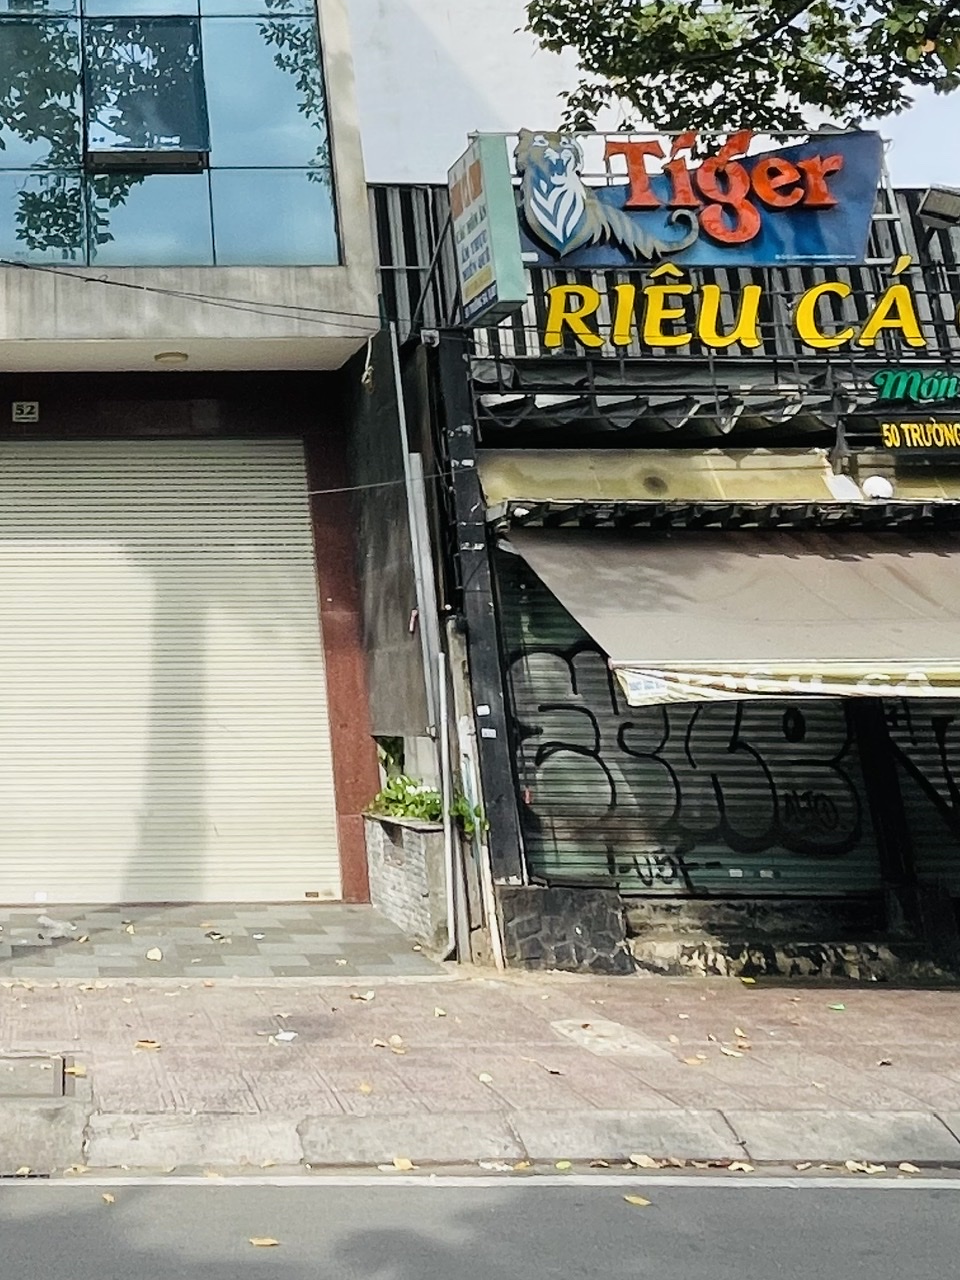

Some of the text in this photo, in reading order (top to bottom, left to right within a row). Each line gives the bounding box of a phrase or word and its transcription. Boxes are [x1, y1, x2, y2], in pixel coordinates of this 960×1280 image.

[605, 129, 844, 243] Tiger
[544, 255, 927, 348] RIÊU CÁ
[15, 404, 35, 416] 52
[882, 423, 901, 448] 50
